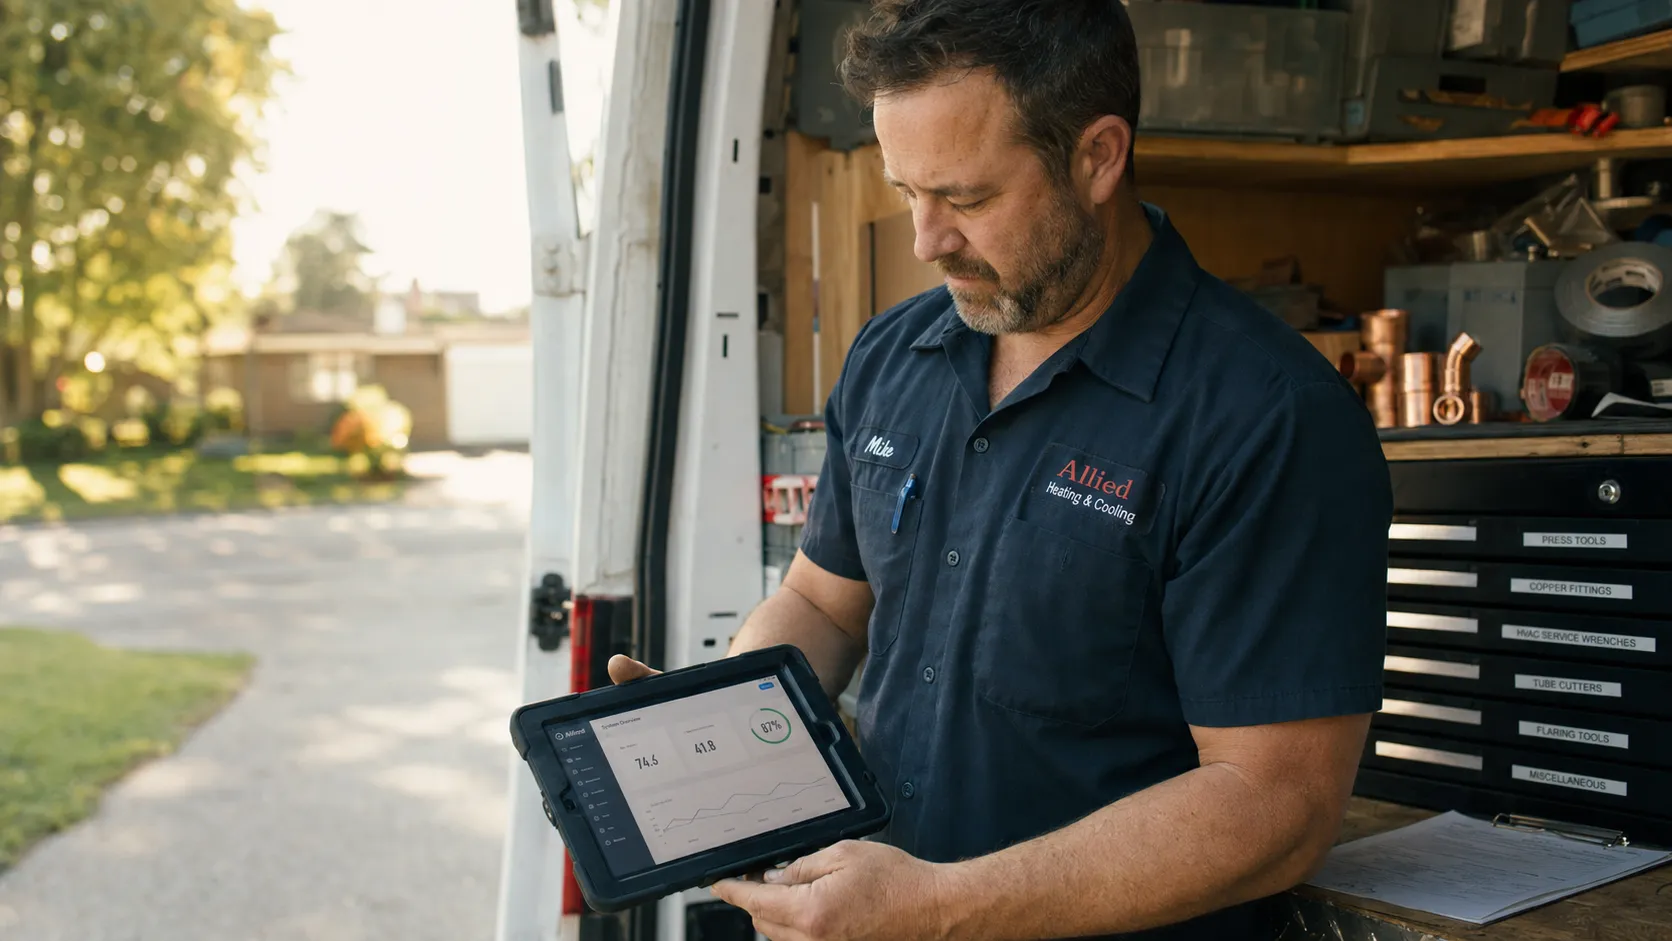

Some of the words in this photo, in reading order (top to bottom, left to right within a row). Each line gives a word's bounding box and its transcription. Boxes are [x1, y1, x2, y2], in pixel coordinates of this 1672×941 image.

[864, 435, 894, 458] Mike
[1056, 459, 1134, 501] Allied
[1045, 481, 1083, 506] Heating
[1082, 494, 1093, 508] &
[1094, 498, 1136, 526] Cooling
[1541, 535, 1573, 546] PRESS
[1574, 536, 1607, 547] TOOLS
[1529, 581, 1567, 594] COPPER
[1569, 584, 1612, 597] FITTINGS
[1516, 628, 1541, 640] HVAC
[1541, 630, 1580, 644] SERVICE
[1581, 634, 1637, 648] WRENCHES
[1532, 678, 1557, 690] TUBE
[1558, 680, 1603, 693] CUTTERS
[760, 719, 783, 735] 87%
[1536, 725, 1576, 740] FLARING
[1577, 730, 1610, 744] TOOLS
[694, 739, 717, 754] 41.8
[1529, 769, 1607, 791] MISCELLANEOUS
